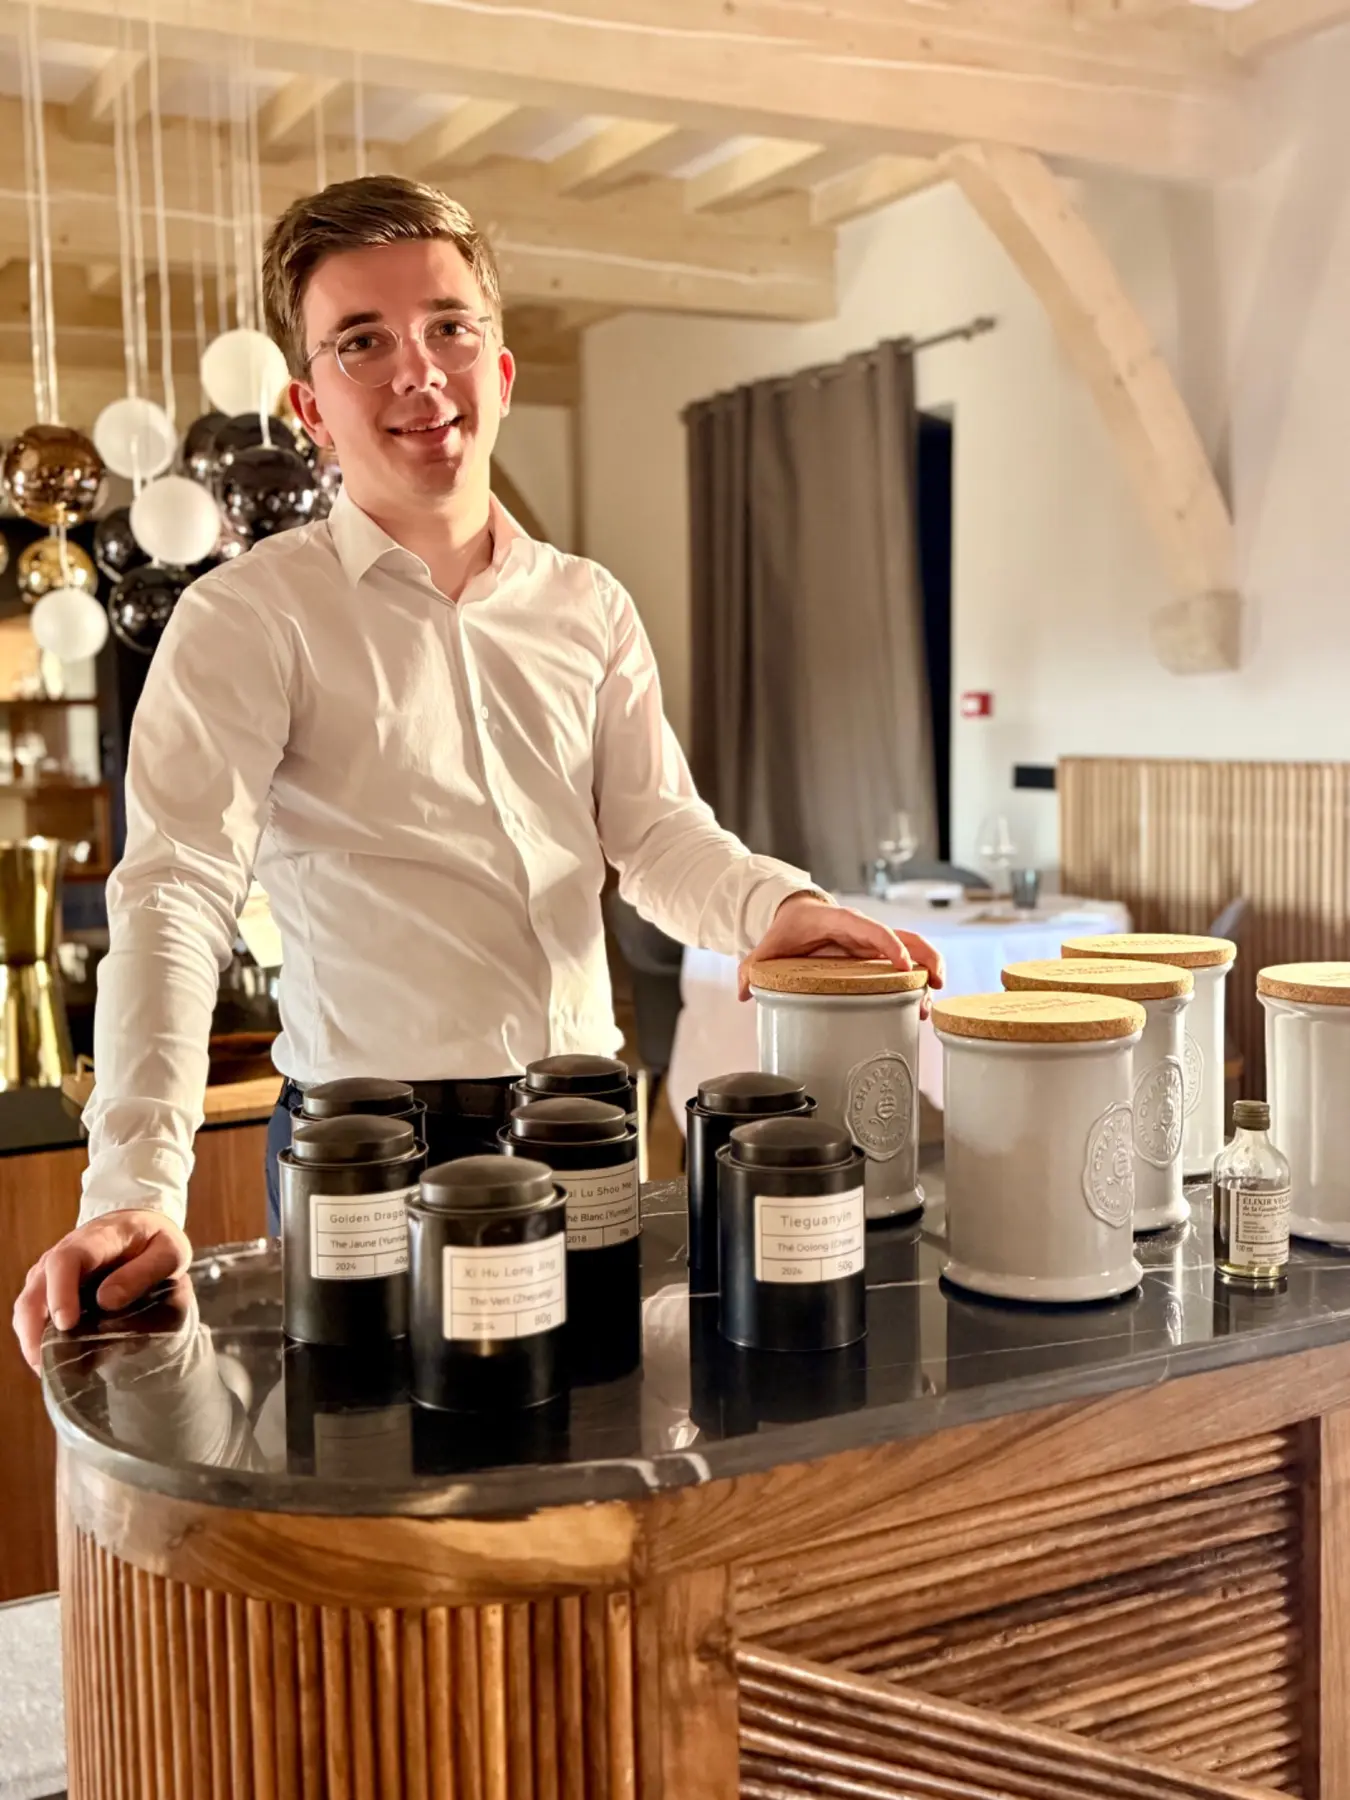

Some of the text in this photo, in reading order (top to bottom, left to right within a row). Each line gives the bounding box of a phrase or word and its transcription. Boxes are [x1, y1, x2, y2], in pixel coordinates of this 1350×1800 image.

[581, 1188, 594, 1198] Lu
[596, 1186, 620, 1196] Shou
[329, 1213, 371, 1224] Golden
[580, 1212, 606, 1222] Blanc
[780, 1211, 852, 1230] Tieguanyin
[349, 1239, 377, 1249] Jaune
[797, 1243, 829, 1253] Oolong
[335, 1262, 357, 1271] 2024
[464, 1268, 476, 1278] Xi
[481, 1268, 499, 1278] Hu
[504, 1266, 534, 1277] Long
